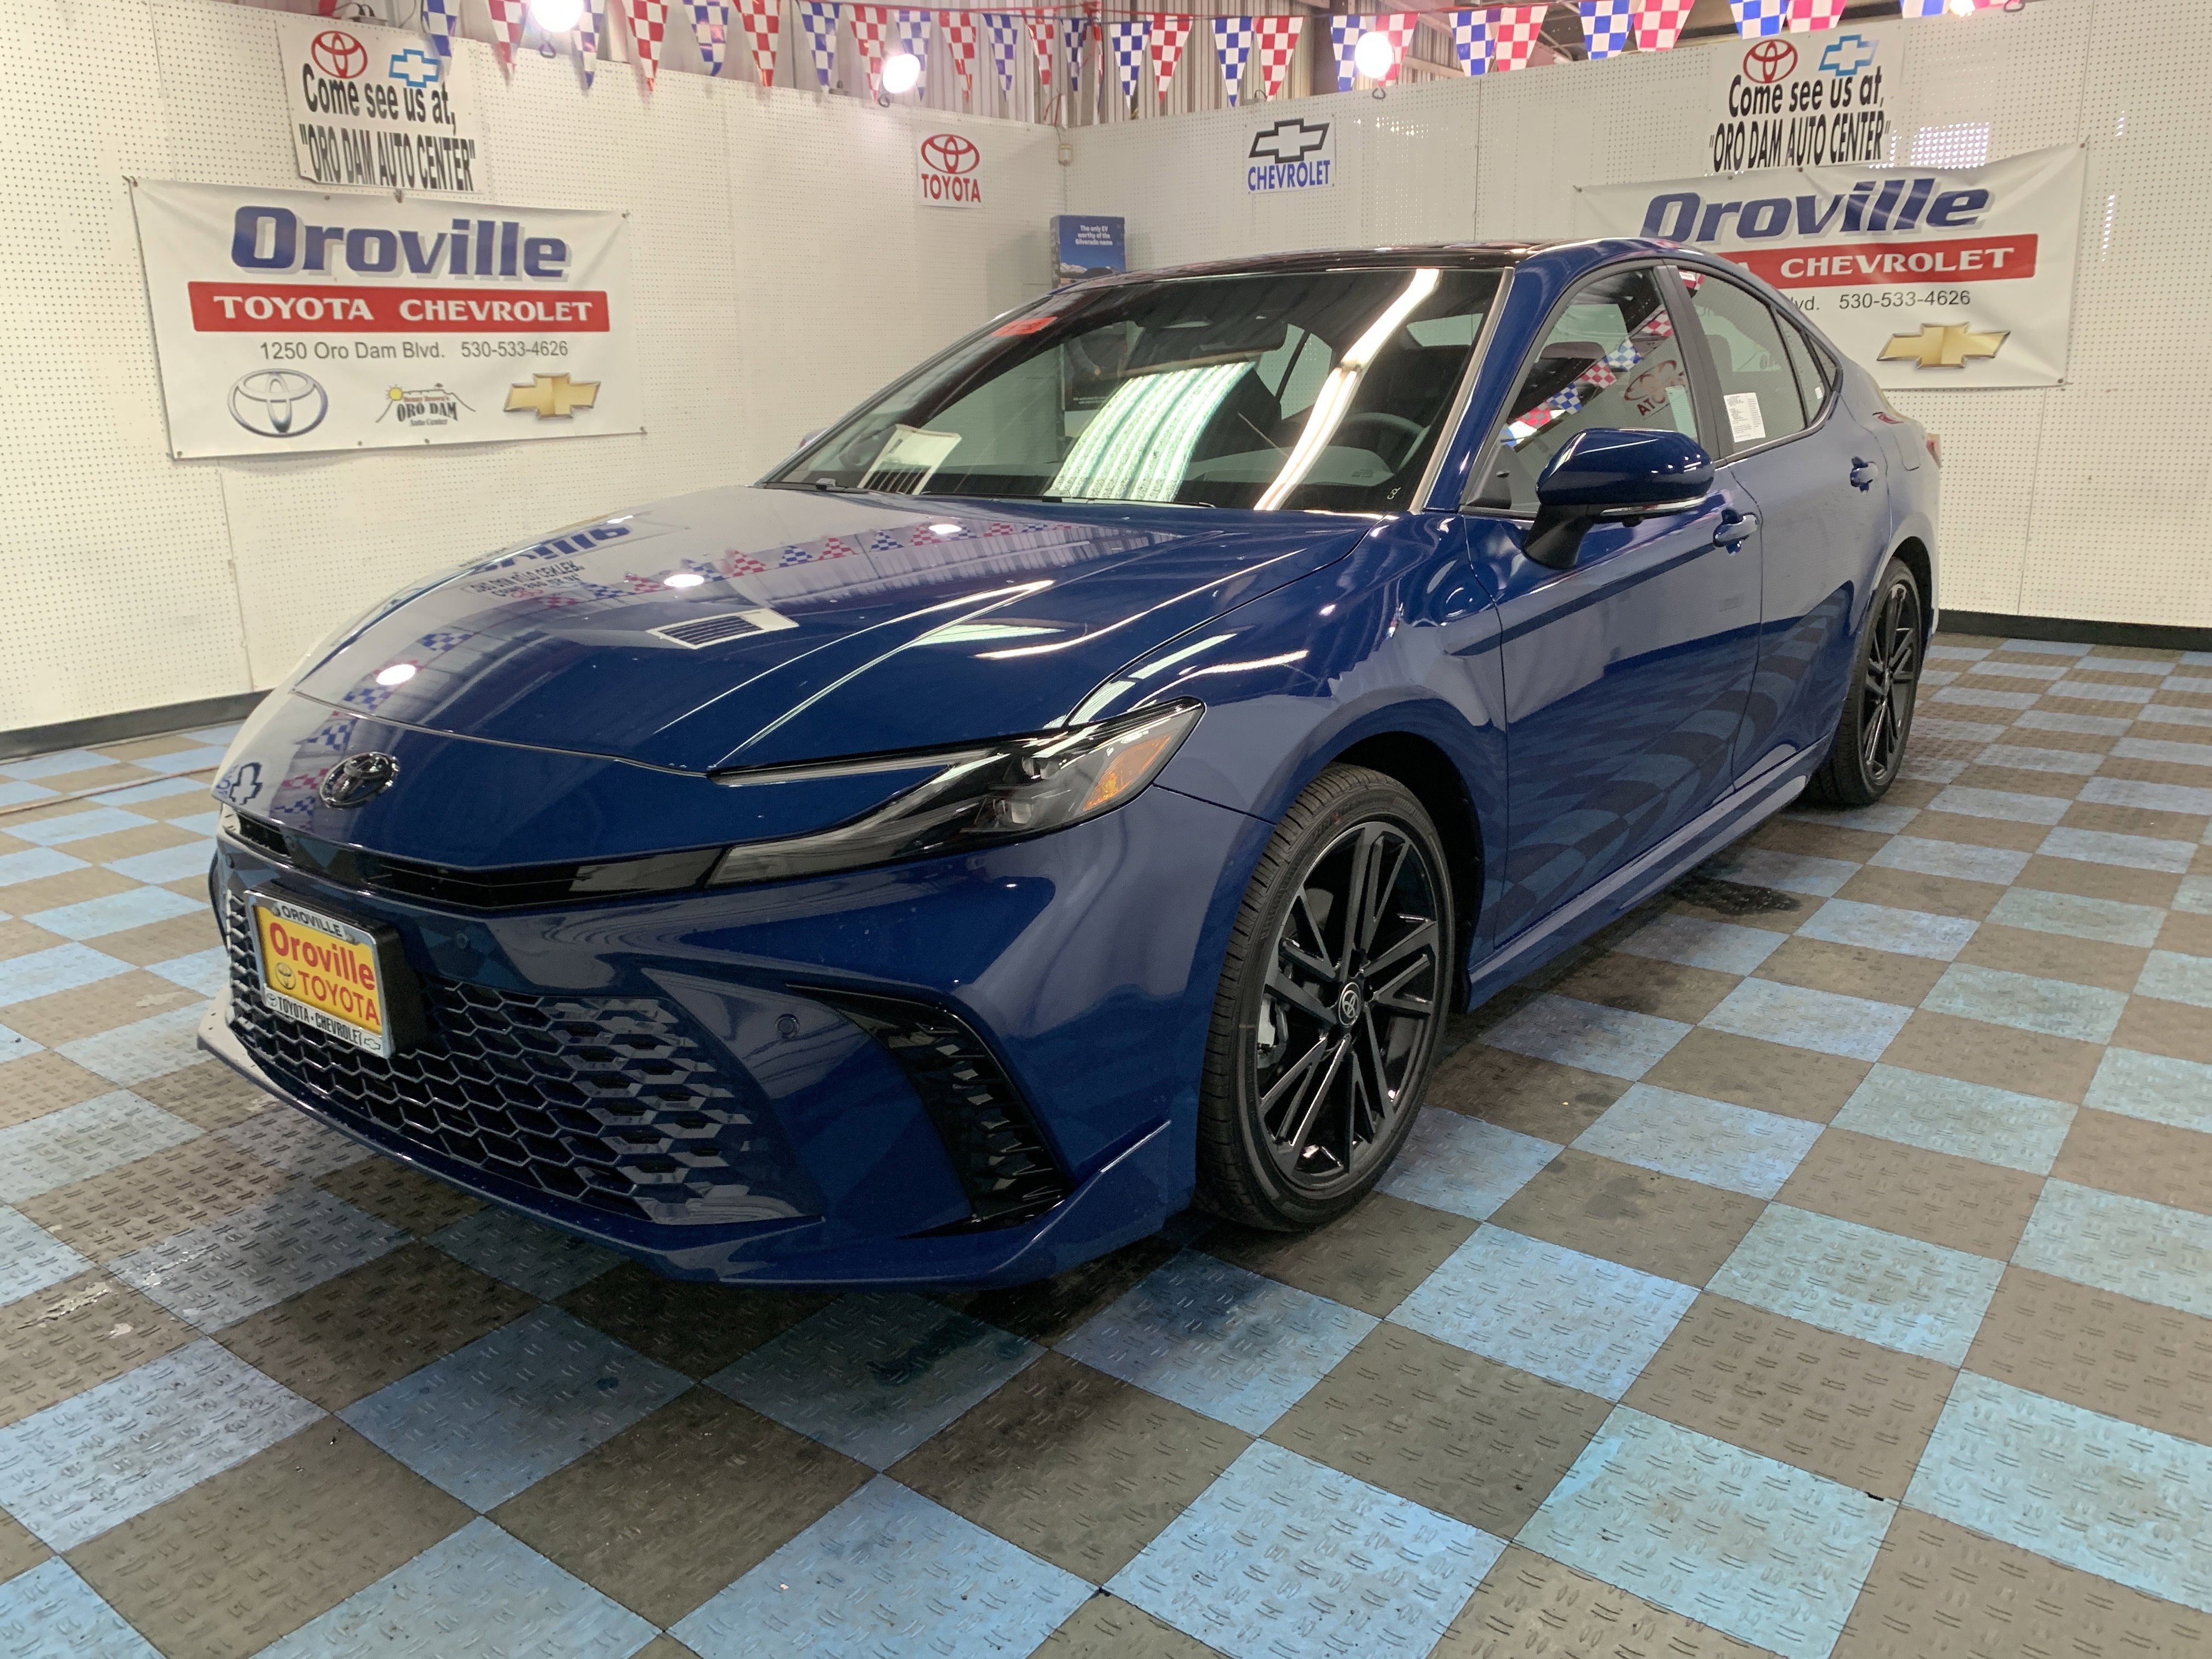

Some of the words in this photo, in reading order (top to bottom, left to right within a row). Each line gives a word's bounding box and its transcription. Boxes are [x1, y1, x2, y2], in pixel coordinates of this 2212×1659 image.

[302, 63, 360, 116] Come
[364, 83, 399, 120] see
[403, 87, 426, 123] us
[431, 82, 456, 136] at,
[1729, 74, 1783, 117] Come
[1789, 79, 1824, 112] see
[1830, 76, 1852, 109] us
[1860, 65, 1885, 108] at,
[299, 123, 341, 183] "ORO
[341, 127, 376, 185] DAM
[377, 131, 415, 188] AUTO
[417, 134, 476, 191] CENTER"
[1708, 120, 1745, 173] "ORO
[1747, 119, 1784, 169] DAM
[1784, 114, 1826, 167] AUTO
[1830, 110, 1892, 163] CENTER"
[921, 173, 981, 204] TOYOTA
[1247, 160, 1331, 192] CHEVROLET
[1639, 178, 1990, 246] Oroville
[230, 205, 568, 279] Oroville
[1780, 247, 2015, 279] CHEVROLET
[213, 295, 374, 321] TOYOTA
[399, 297, 593, 321] CHEVROLET
[1838, 290, 1972, 310] 530-533-4626
[260, 341, 307, 361] 1250
[313, 341, 349, 360] Oro
[356, 341, 397, 360] Dam
[403, 340, 445, 359] Blvd.
[461, 340, 569, 358] 530-533-4626
[397, 403, 425, 422] ORO
[429, 402, 459, 421] DAM
[281, 905, 343, 938] OROVILLE
[269, 922, 376, 991] Oroville
[276, 996, 310, 1023] TOYOTA
[314, 1012, 363, 1046] CHEVROLET
[297, 969, 382, 1026] TOYOTA
